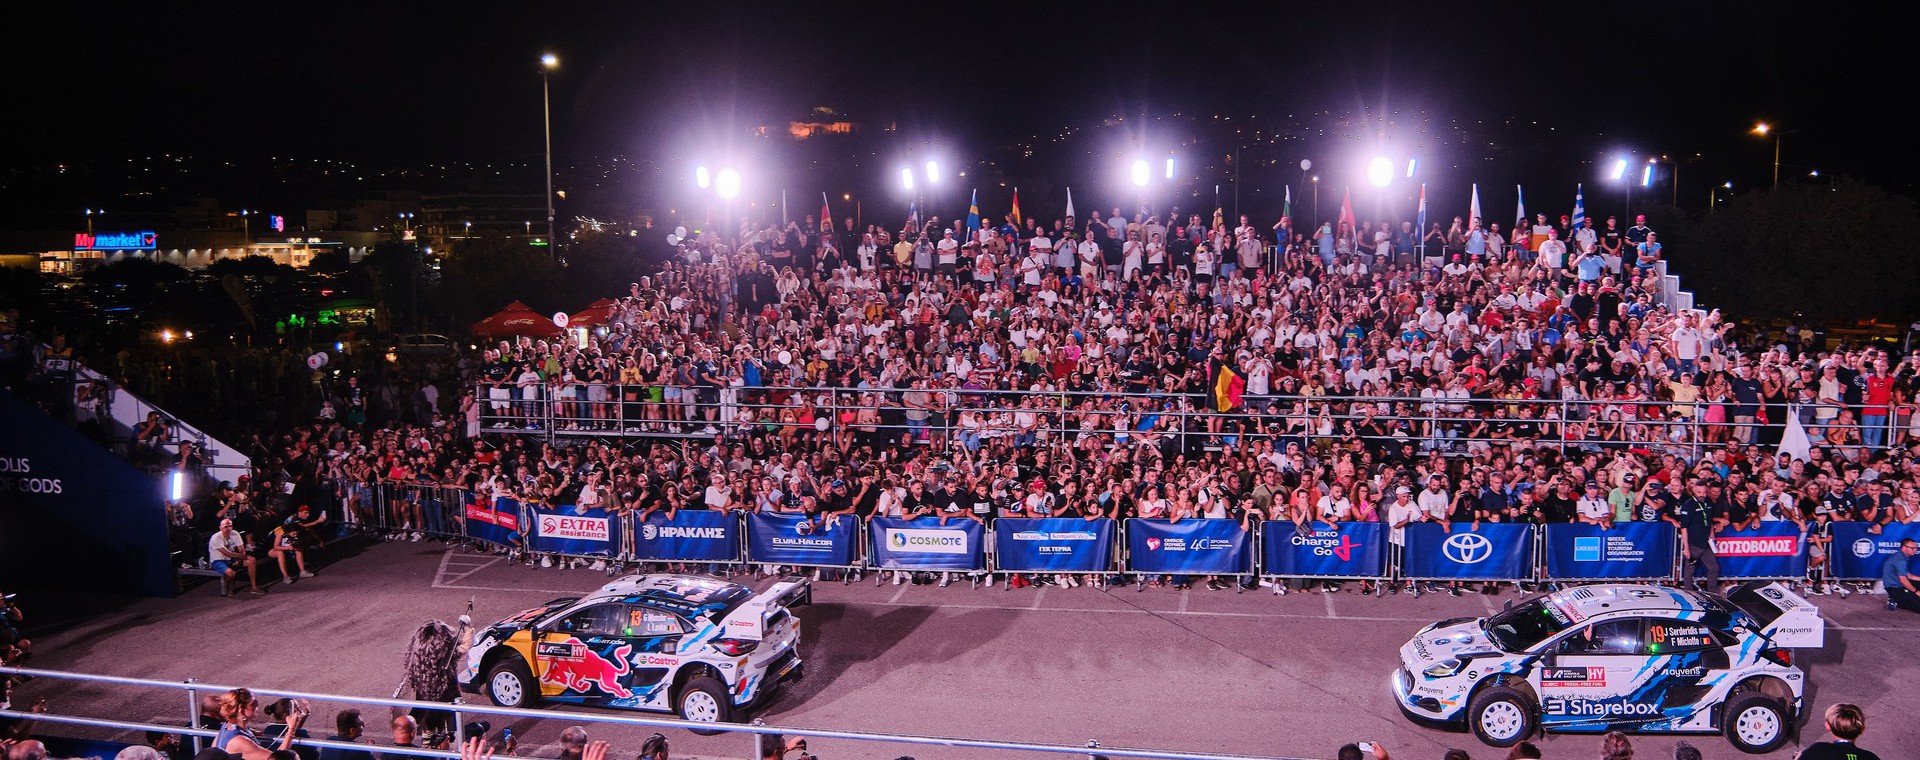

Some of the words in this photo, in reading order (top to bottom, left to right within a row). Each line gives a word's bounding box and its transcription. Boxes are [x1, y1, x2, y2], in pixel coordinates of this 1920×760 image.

[75, 233, 95, 250] My
[95, 232, 141, 248] market
[19, 477, 62, 494] GODS
[560, 518, 606, 532] EXTRA
[560, 530, 607, 538] assistance
[659, 526, 725, 539] ΗΡΑΚΛΗΣ
[910, 536, 962, 546] COSMOTE
[1291, 536, 1340, 547] Charge
[1313, 547, 1333, 556] Go
[631, 610, 642, 626] 13
[1650, 625, 1665, 643] 19
[1786, 627, 1813, 635] ayvens
[573, 646, 585, 657] HY
[648, 656, 679, 666] Castrol
[1589, 668, 1604, 680] HY
[1669, 668, 1701, 678] ayvens
[1570, 699, 1659, 715] Sharebox
